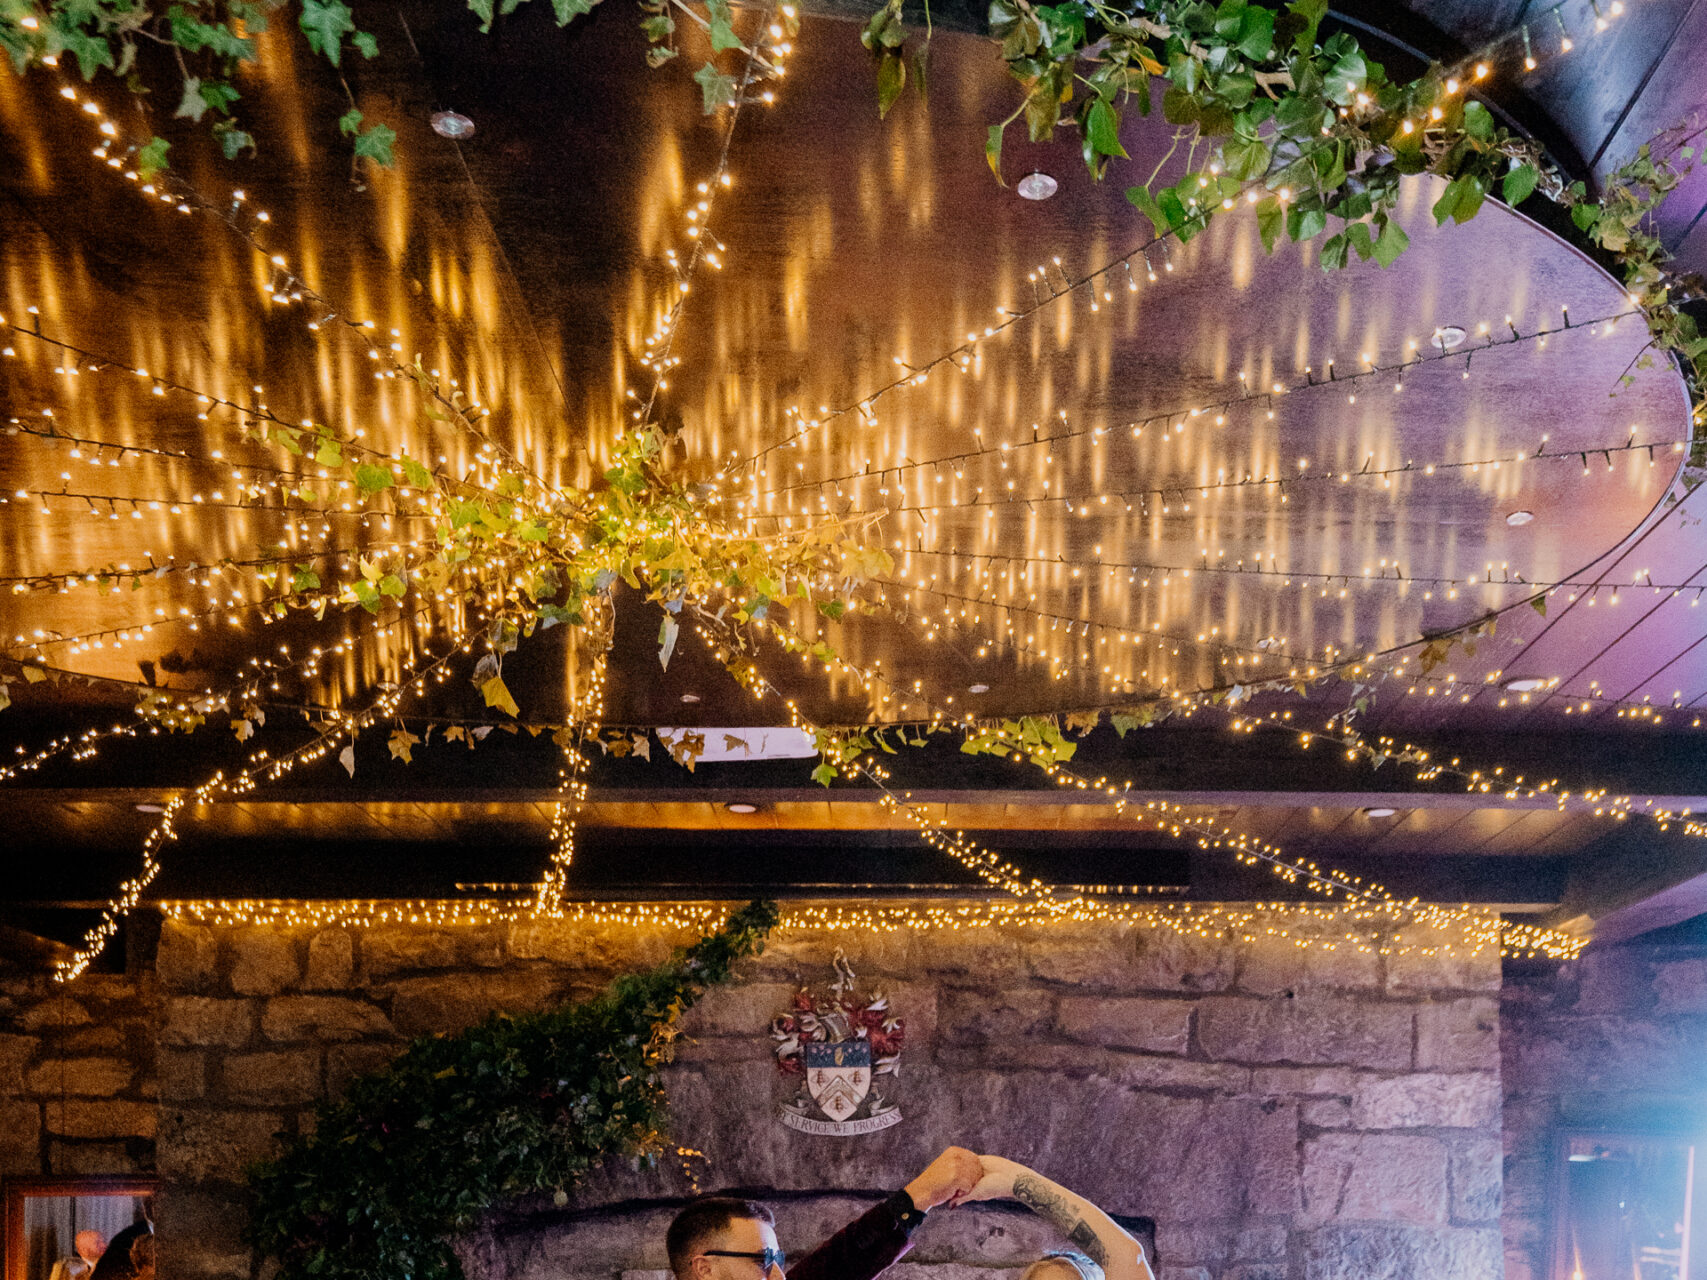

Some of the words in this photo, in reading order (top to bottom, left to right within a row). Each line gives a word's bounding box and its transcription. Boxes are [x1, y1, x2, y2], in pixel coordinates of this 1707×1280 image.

[790, 1114, 829, 1133] SERVICE
[833, 1121, 847, 1133] WE
[853, 1110, 902, 1132] PROGRESS
